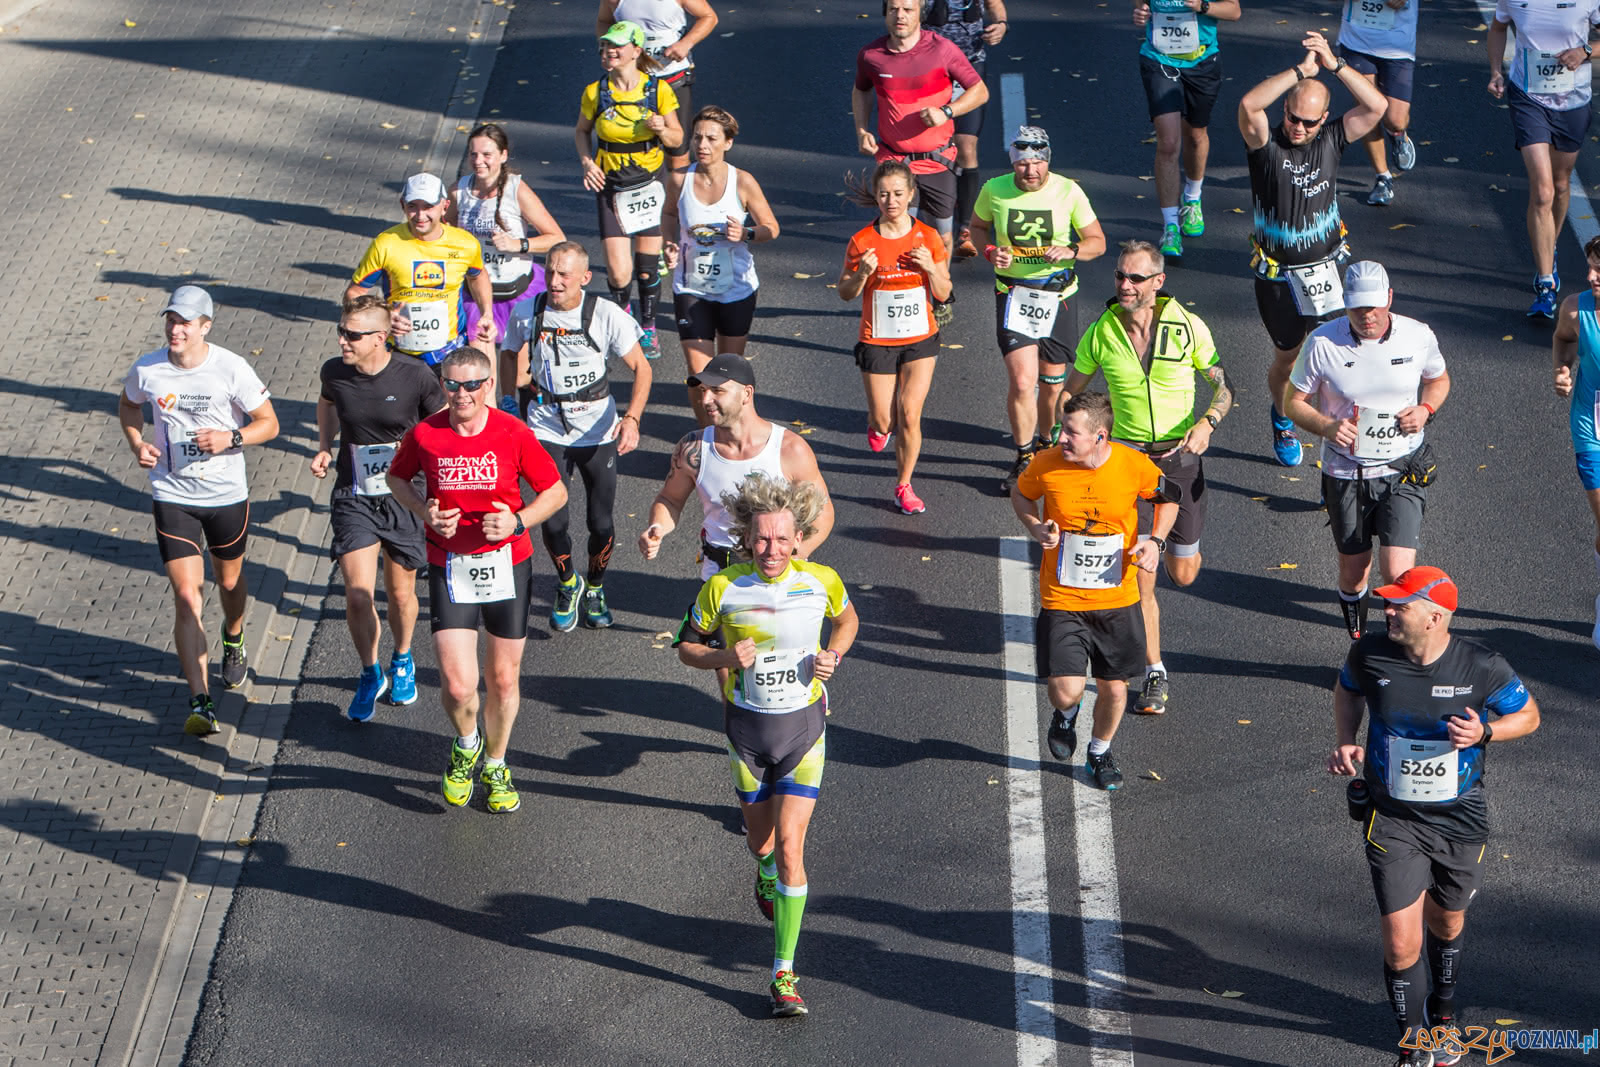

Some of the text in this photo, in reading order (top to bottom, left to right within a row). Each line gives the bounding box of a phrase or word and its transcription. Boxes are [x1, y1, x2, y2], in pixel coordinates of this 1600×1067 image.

[1361, 1, 1384, 13] 529
[1161, 26, 1190, 37] 3704
[645, 47, 662, 57] 54
[1536, 64, 1565, 76] 1672
[1302, 180, 1330, 198] Team
[626, 196, 658, 214] 3763
[1015, 256, 1048, 264] runne
[698, 263, 720, 275] 575
[1302, 280, 1332, 297] 5026
[887, 303, 919, 318] 5788
[1018, 303, 1052, 320] 5206
[563, 371, 596, 388] 5128
[363, 460, 393, 475] 166
[437, 455, 489, 467] DRUŻYNA
[438, 466, 498, 482] SZPIKU
[469, 567, 495, 581] 951
[755, 669, 797, 686] 5578
[1400, 760, 1447, 777] 5266
